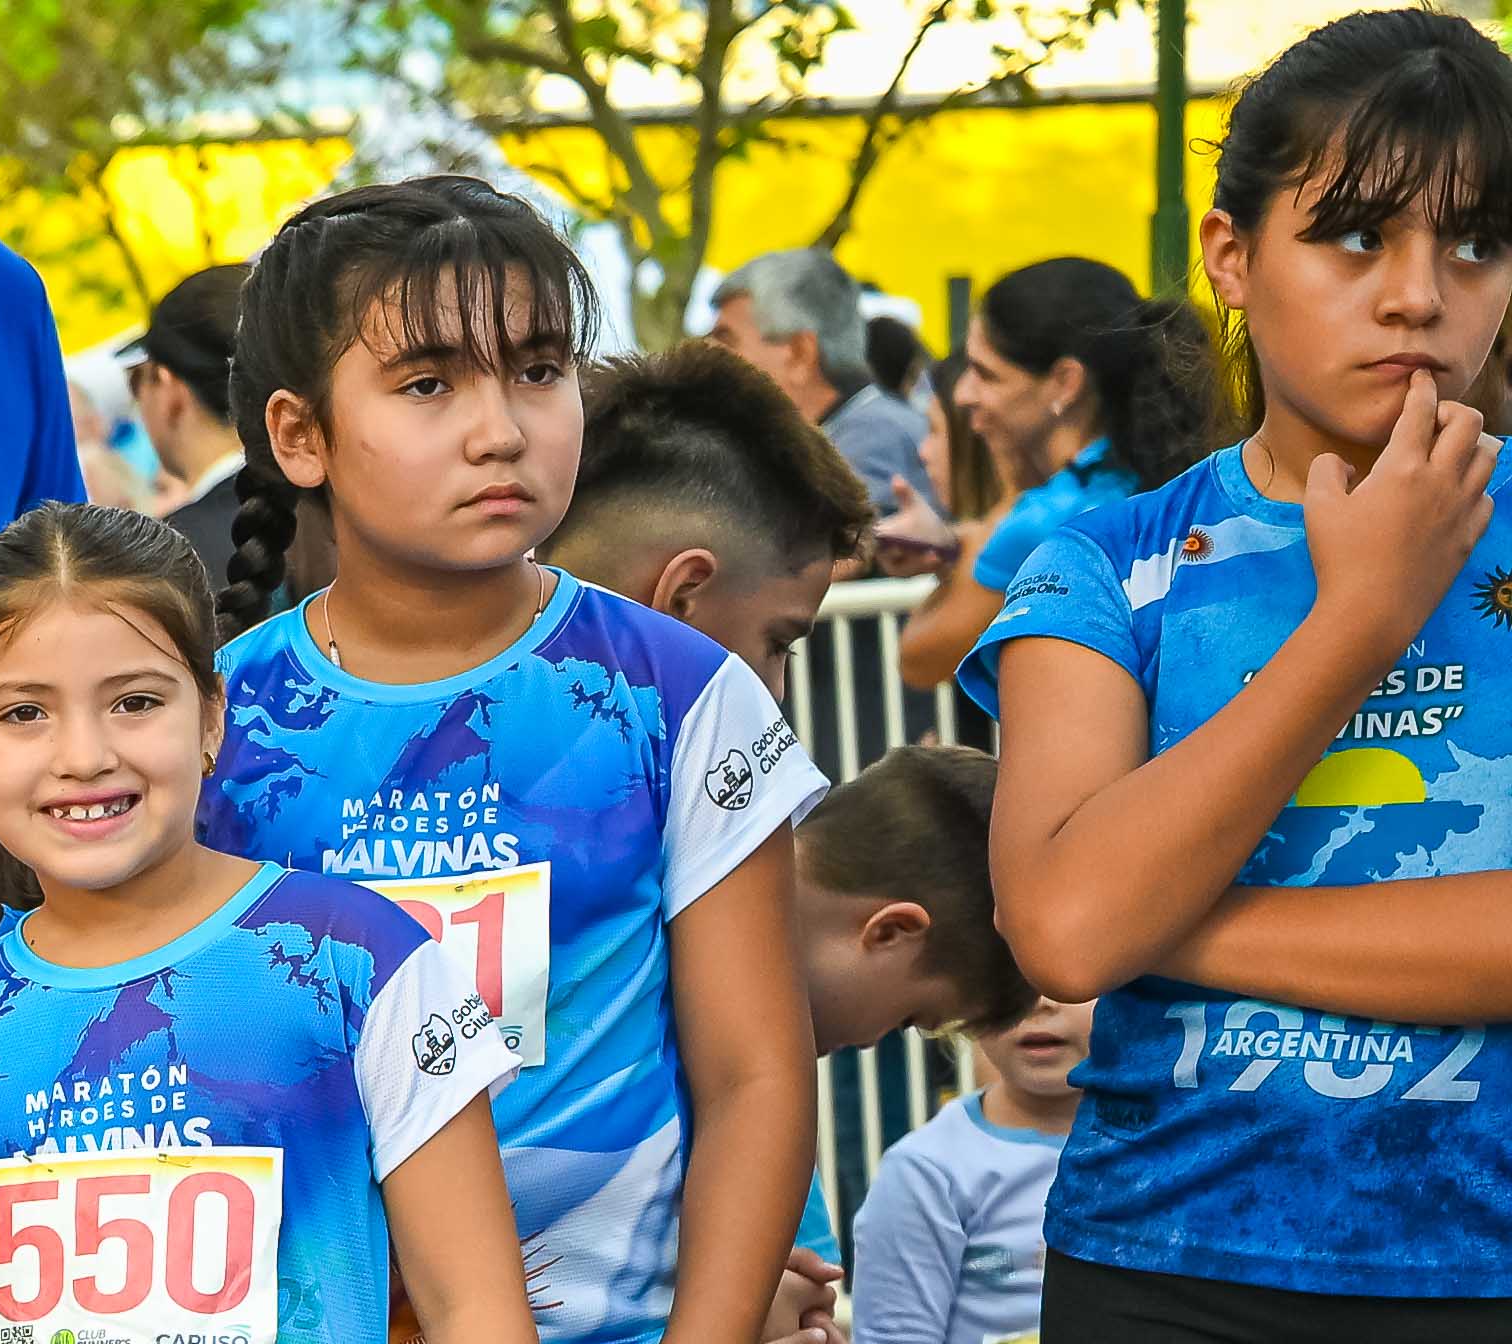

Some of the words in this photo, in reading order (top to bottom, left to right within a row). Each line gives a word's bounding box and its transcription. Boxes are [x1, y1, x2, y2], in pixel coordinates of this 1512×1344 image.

[1416, 665, 1463, 692] DE
[342, 783, 499, 818] MARATÓN
[464, 807, 498, 828] DE
[1211, 1030, 1414, 1063] ARGENTINA
[25, 1064, 188, 1115] MARATÓN
[28, 1101, 135, 1138] HROES
[152, 1091, 186, 1113] DE
[14, 1117, 214, 1158] ALVINAS
[78, 1329, 106, 1341] CLUB
